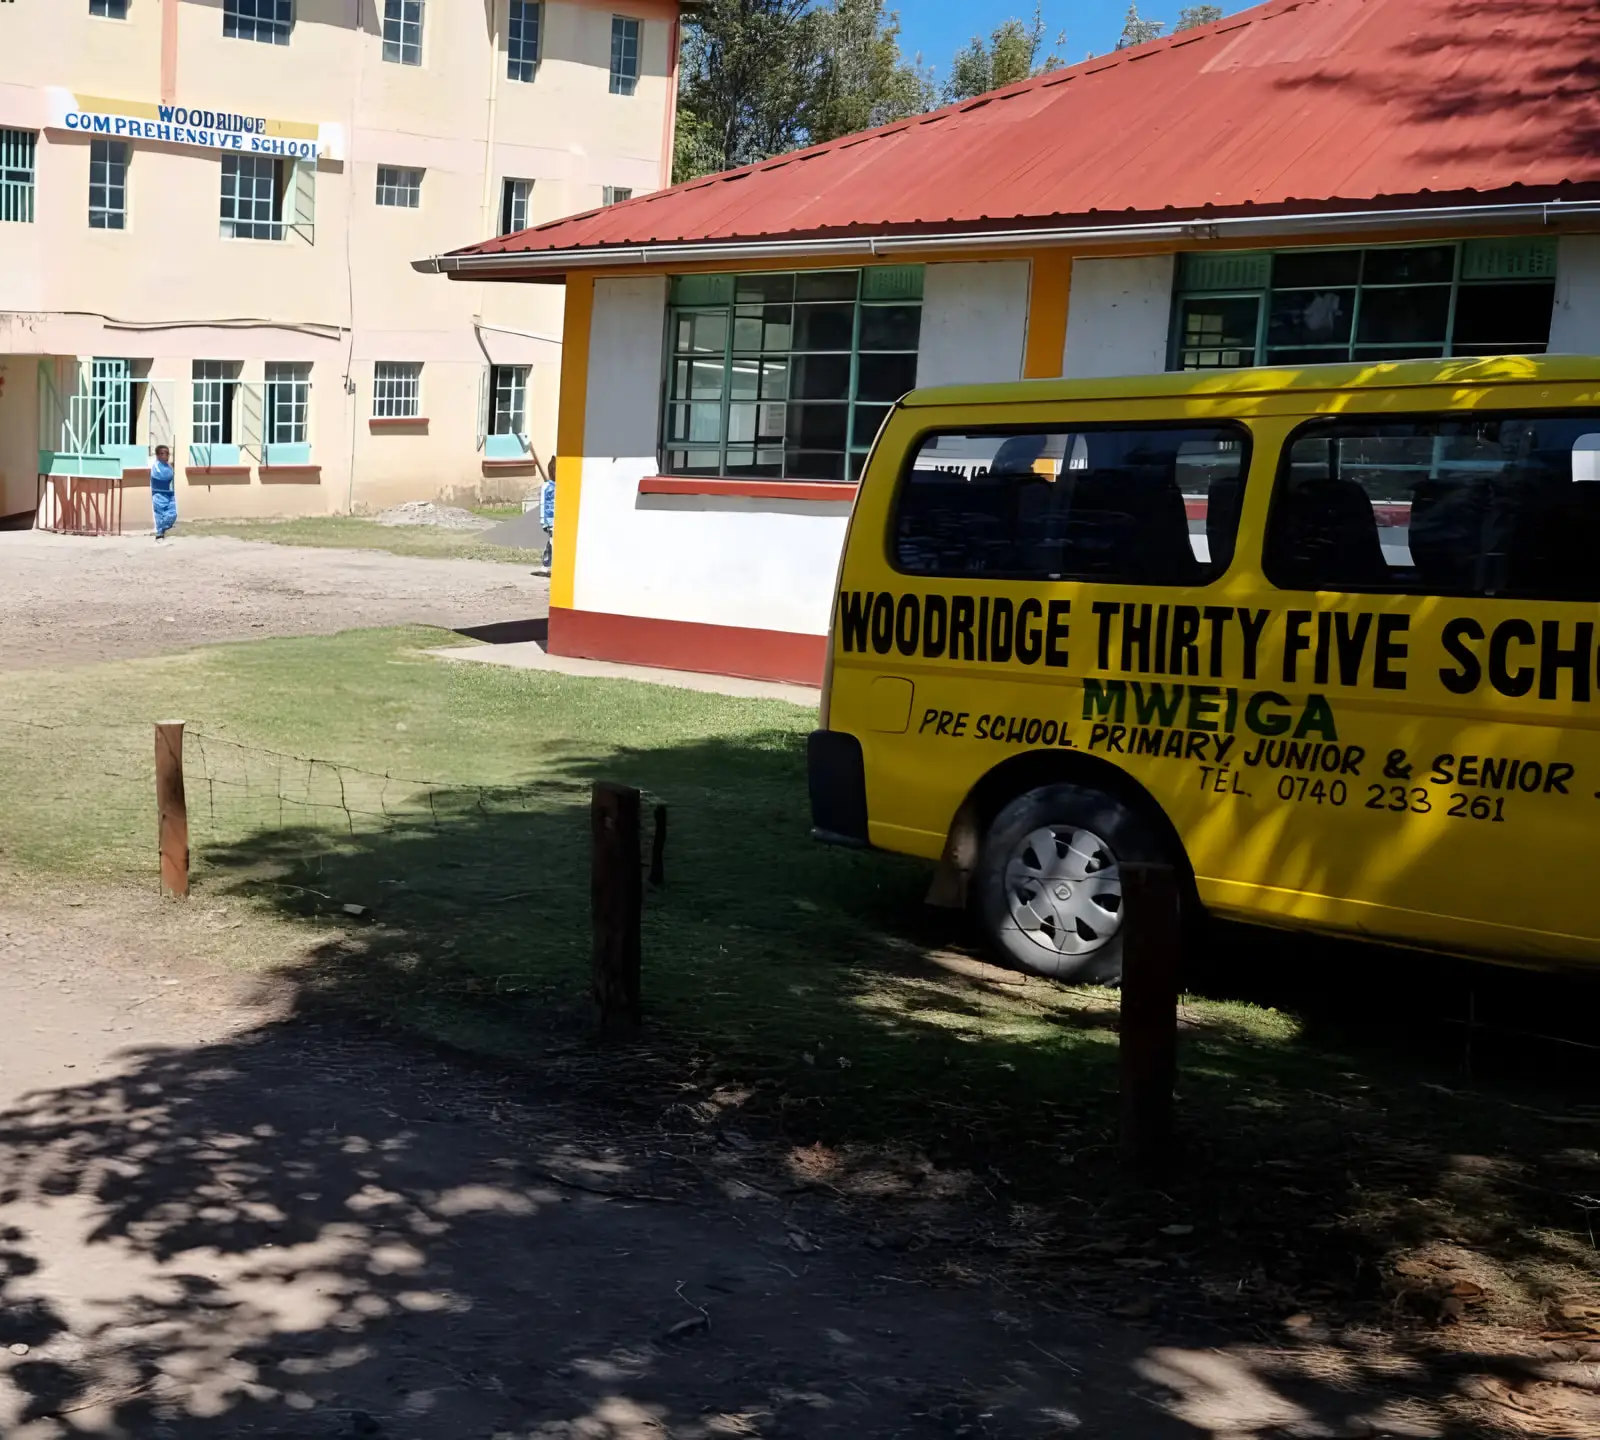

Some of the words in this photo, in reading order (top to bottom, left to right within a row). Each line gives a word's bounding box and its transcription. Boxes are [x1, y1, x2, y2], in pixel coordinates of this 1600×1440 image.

[65, 113, 243, 148] COMPREHENSIVE
[158, 105, 266, 134] WOODRIDGE
[840, 591, 1071, 667] WOODRIDGE
[1092, 602, 1272, 680] THIRTY
[1282, 610, 1410, 690] FIVE
[1439, 617, 1600, 702] SCH
[1081, 678, 1338, 741] MWEIGA
[919, 709, 970, 737] PRE
[1244, 738, 1365, 776] JUNIOR
[1383, 749, 1413, 780] &
[1430, 753, 1575, 794] SENIOR
[1277, 774, 1348, 807] 0740
[1365, 783, 1432, 814] 233
[1447, 793, 1505, 822] 261
